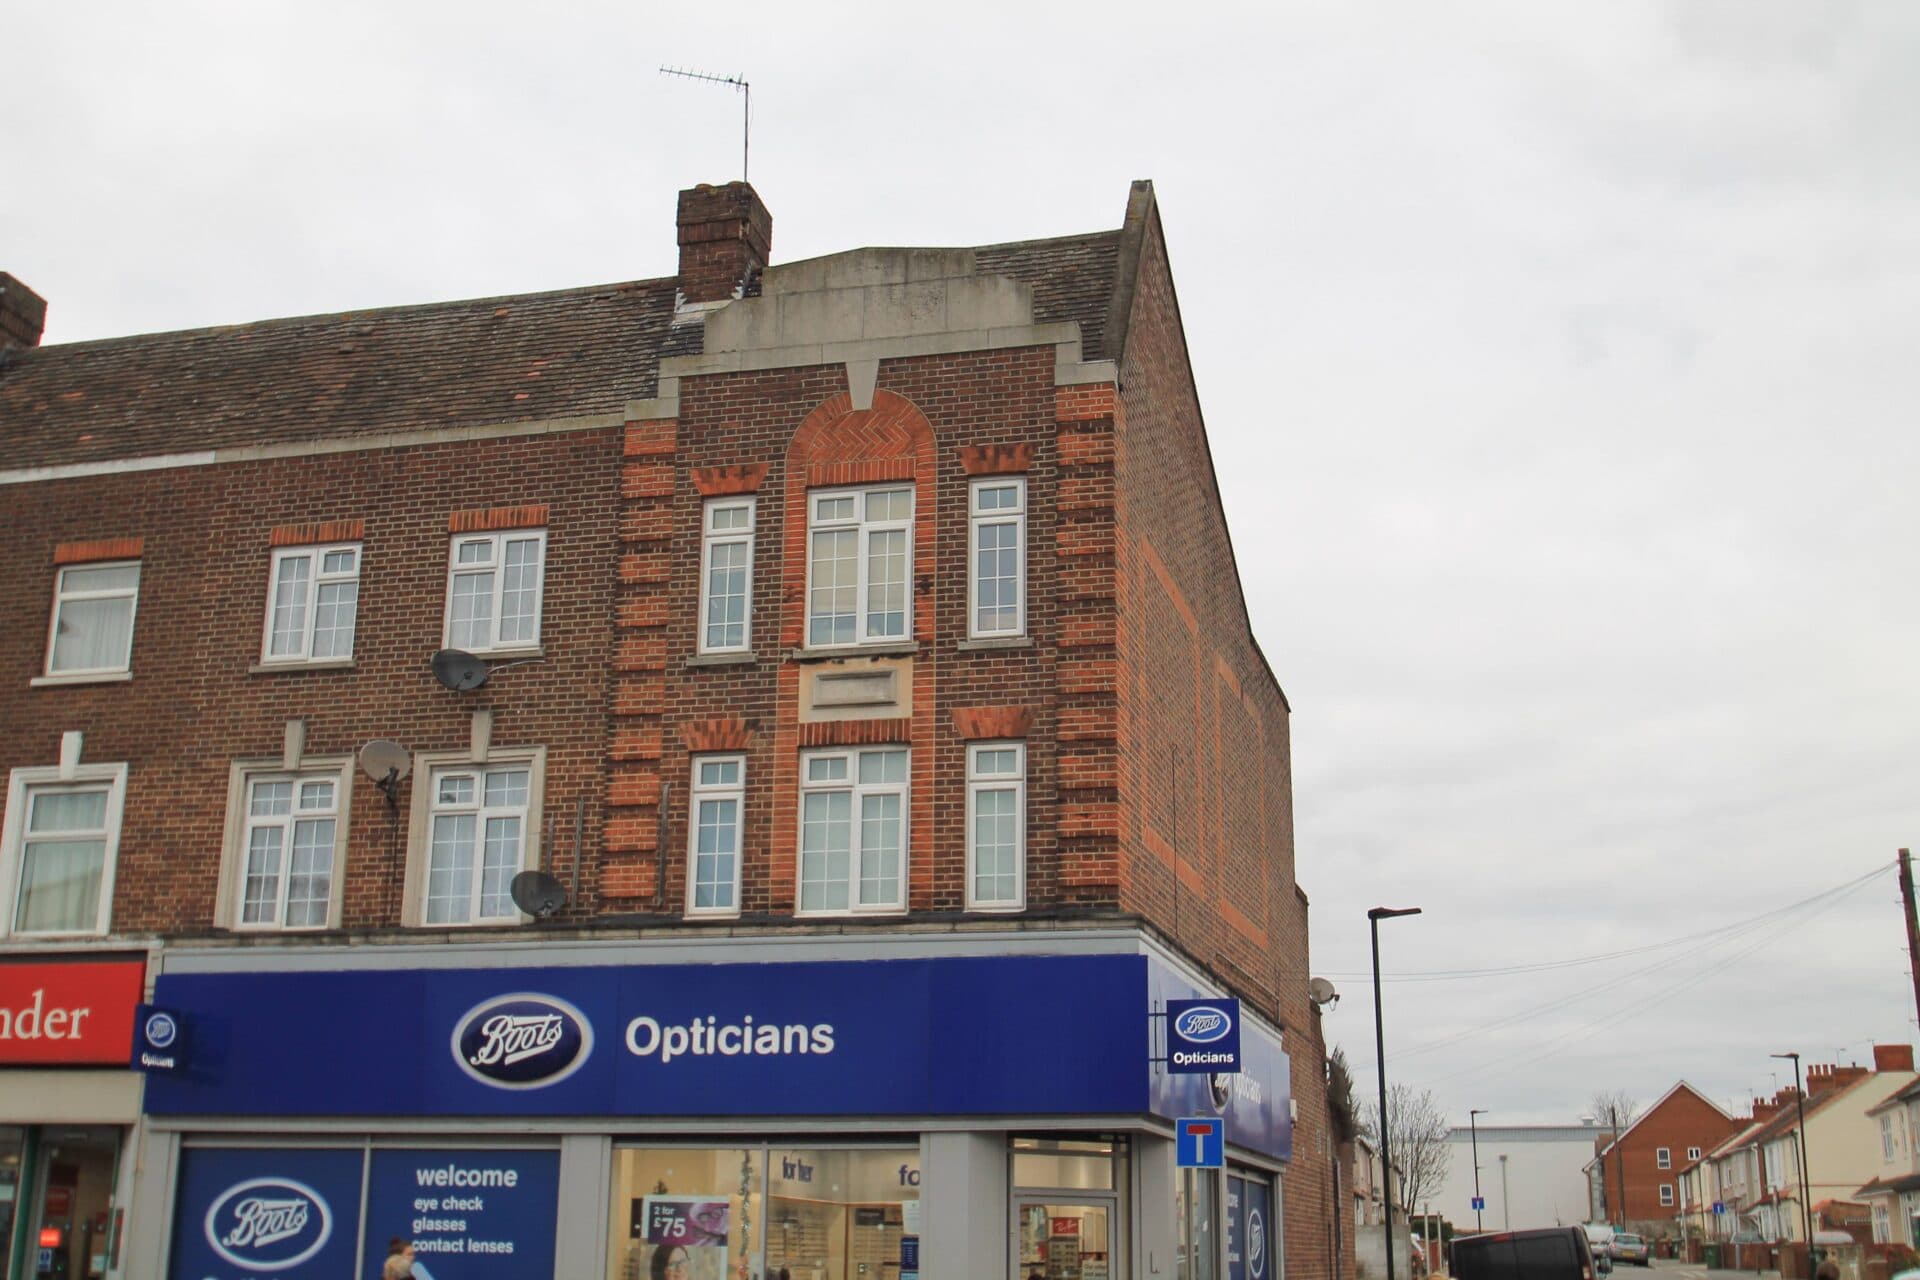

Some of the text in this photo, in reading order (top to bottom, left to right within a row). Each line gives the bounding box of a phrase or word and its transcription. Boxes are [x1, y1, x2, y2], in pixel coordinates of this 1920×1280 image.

[1183, 1014, 1221, 1035] Boots
[469, 1013, 563, 1066] Boots
[625, 1015, 835, 1064] Opticians
[1173, 1051, 1234, 1066] Opticians
[416, 1164, 518, 1187] welcome
[414, 1196, 483, 1212] eye check
[653, 1206, 675, 1215] 2 for
[222, 1198, 308, 1248] Boots
[412, 1216, 466, 1233] glasses
[653, 1217, 686, 1238] £75
[412, 1238, 514, 1253] contact lenses
